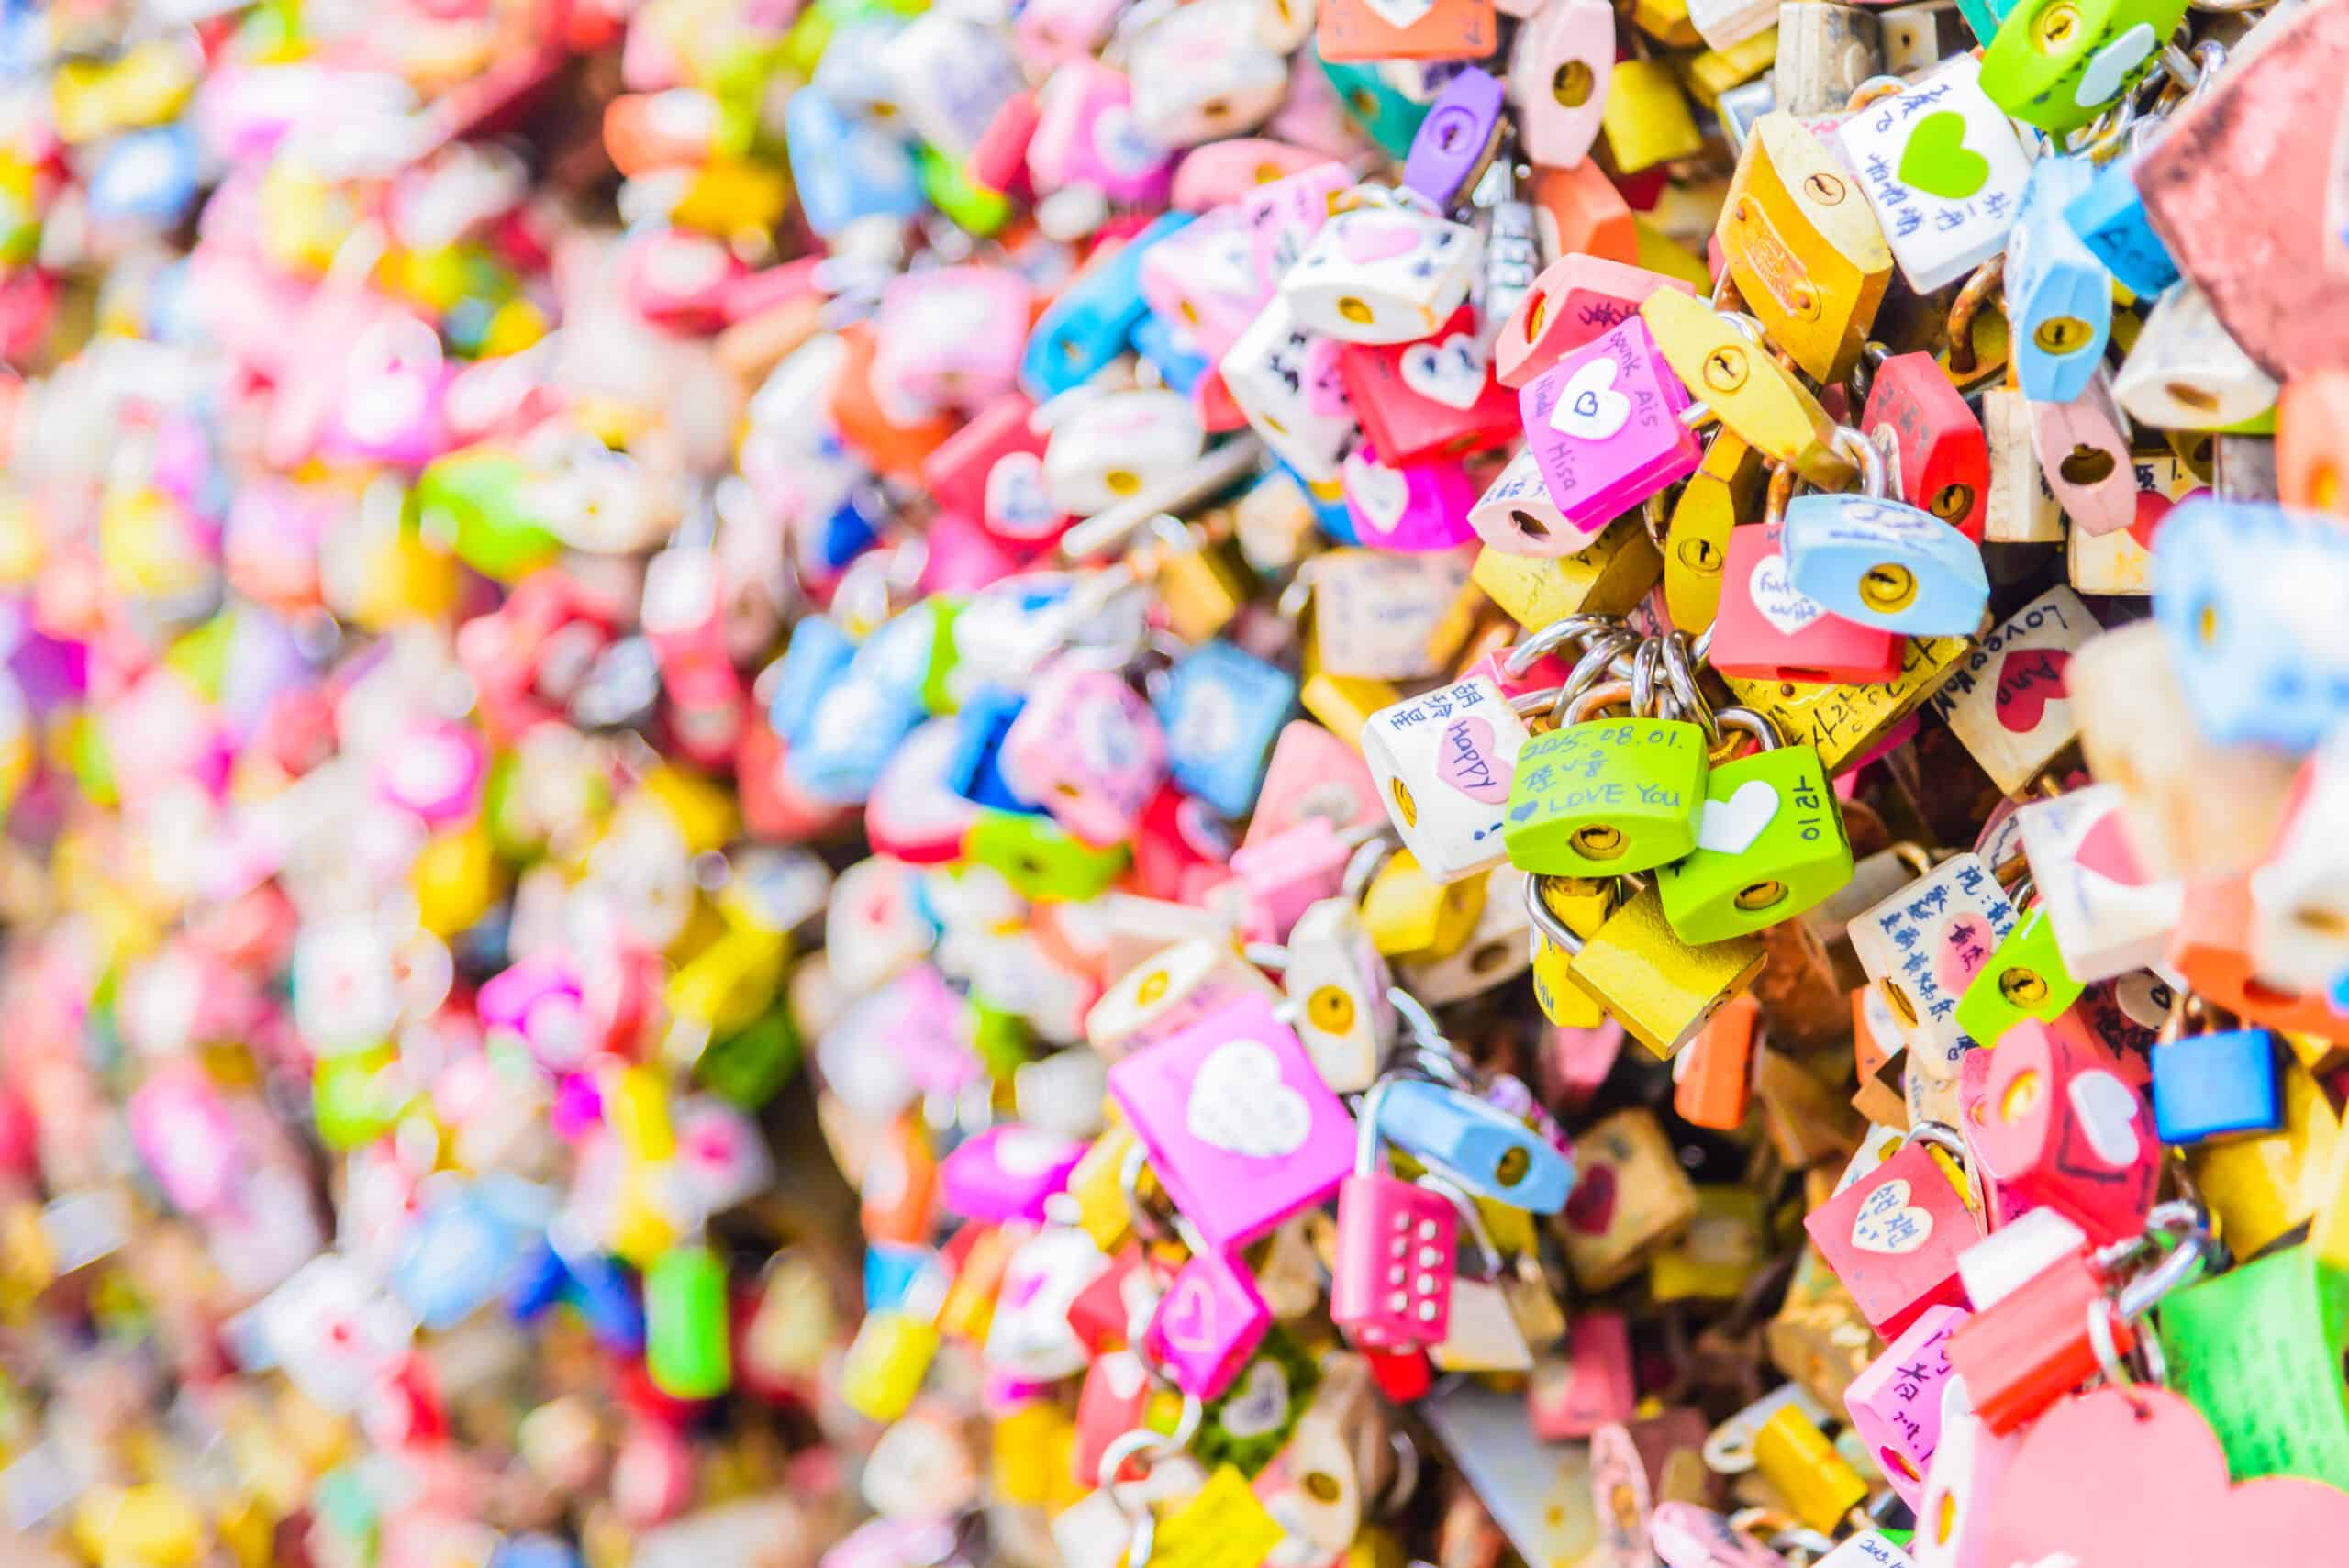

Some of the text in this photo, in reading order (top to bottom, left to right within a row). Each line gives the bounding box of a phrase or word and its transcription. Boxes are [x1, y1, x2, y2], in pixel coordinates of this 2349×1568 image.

[1983, 604, 2068, 652] Love
[1448, 720, 1497, 788] Happy
[1549, 783, 1625, 812] LOVE
